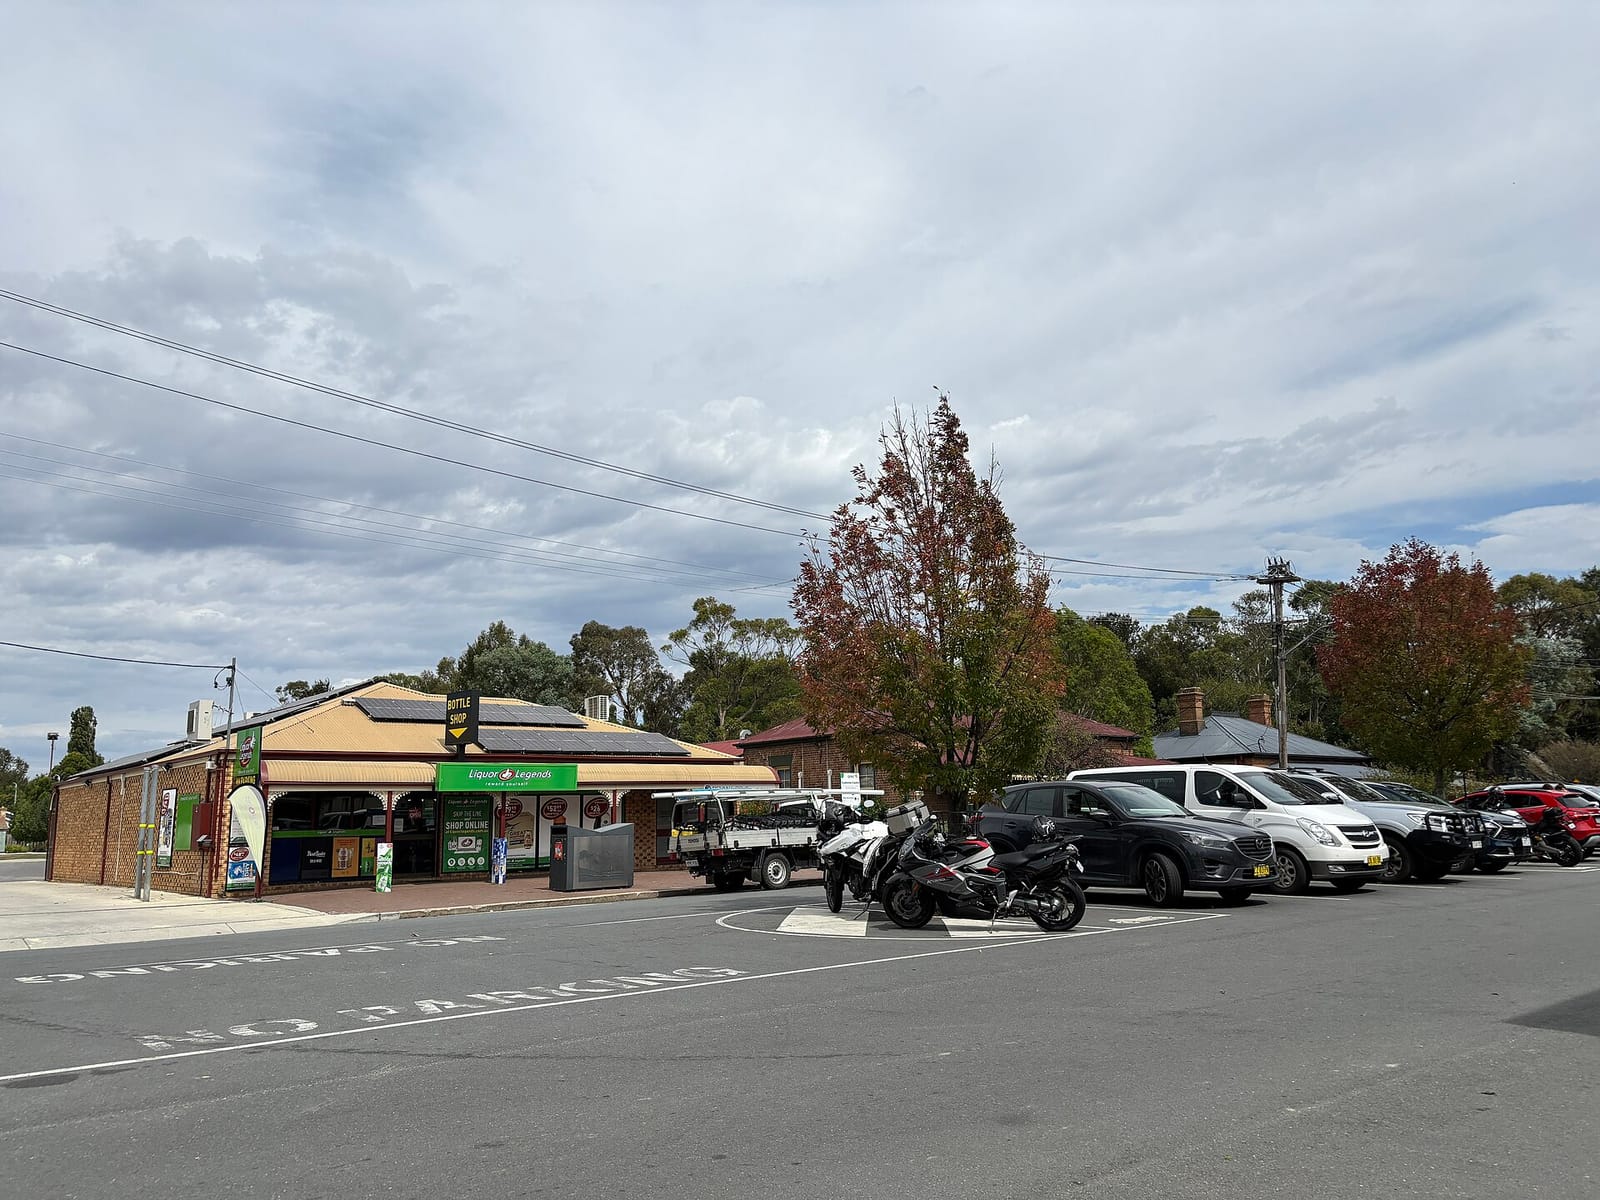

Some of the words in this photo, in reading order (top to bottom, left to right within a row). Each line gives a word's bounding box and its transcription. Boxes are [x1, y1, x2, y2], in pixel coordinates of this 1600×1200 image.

[447, 697, 471, 711] BOTTLE
[450, 713, 467, 725] SHOP
[468, 769, 498, 780] Liquor
[515, 769, 552, 780] Legends
[445, 821, 463, 830] SHOP
[464, 821, 489, 829] ONLINE
[14, 945, 395, 984] PARKING
[336, 967, 751, 1022] PARKING
